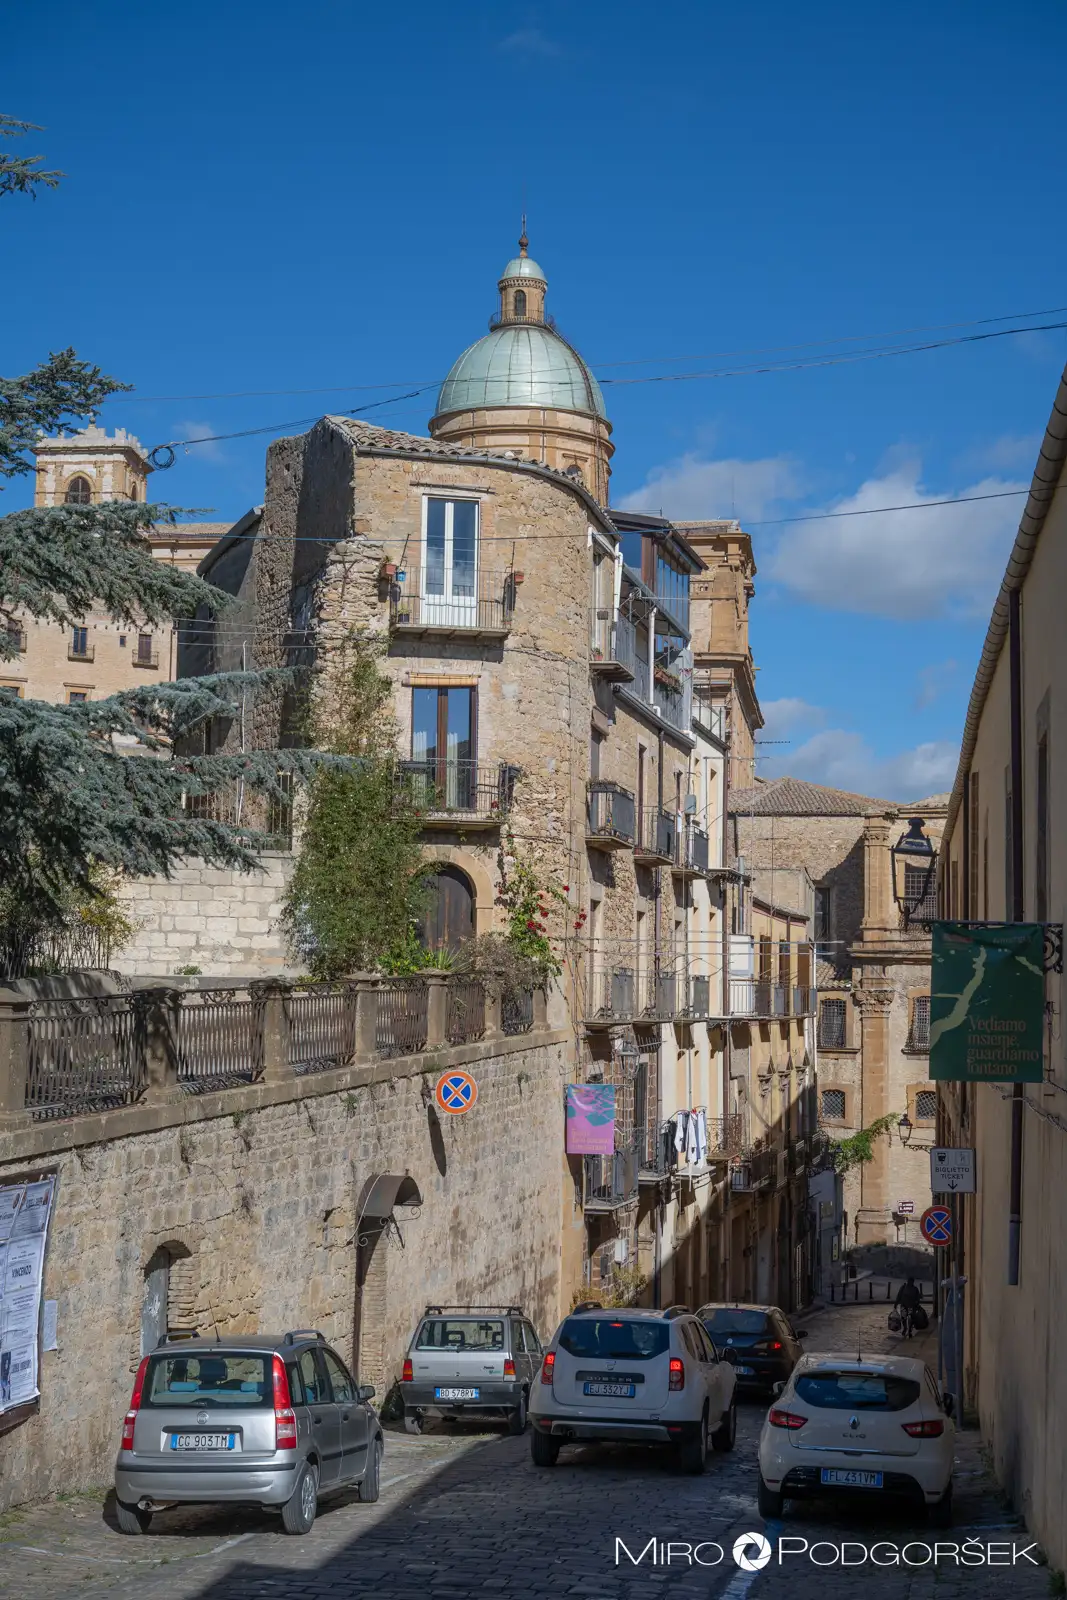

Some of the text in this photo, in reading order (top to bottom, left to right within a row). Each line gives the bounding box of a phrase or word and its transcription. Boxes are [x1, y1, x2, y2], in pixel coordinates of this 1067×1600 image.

[968, 1015, 1027, 1032] Vediamo
[967, 1047, 1039, 1062] guardiamo
[12, 1265, 32, 1278] VINCENZO
[589, 1384, 629, 1395] EJ 332YJ
[178, 1435, 228, 1447] CG 903TM
[829, 1470, 877, 1485] FL 431VM
